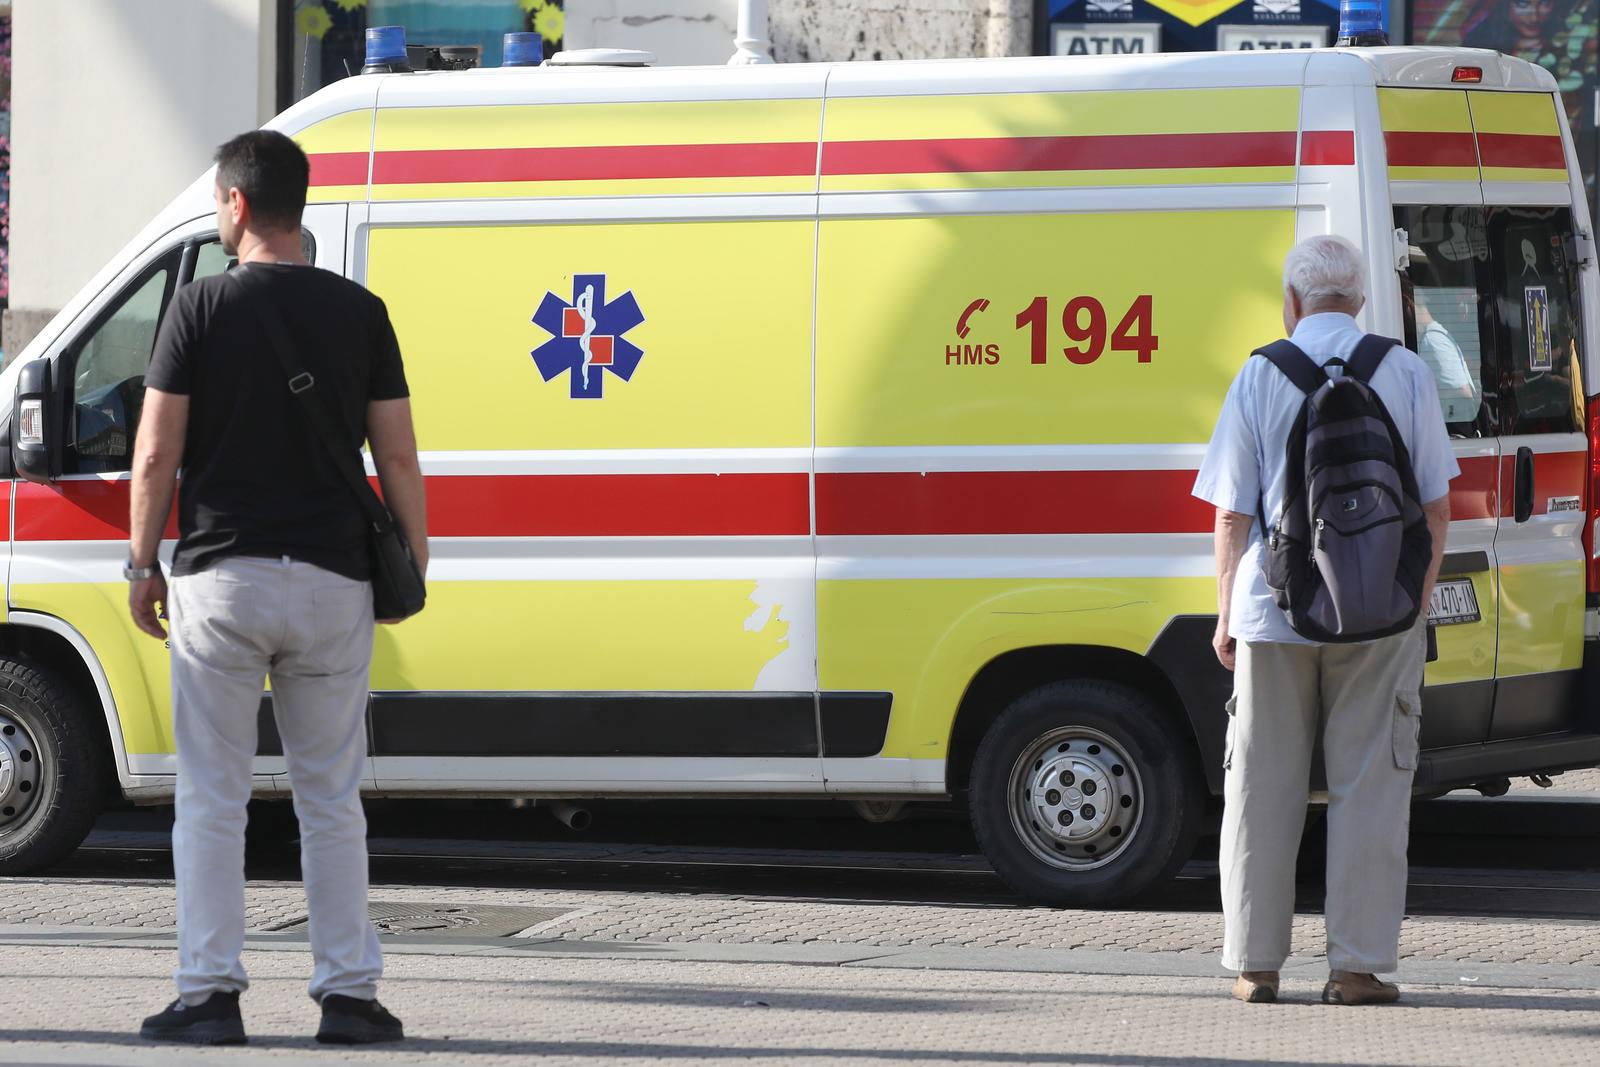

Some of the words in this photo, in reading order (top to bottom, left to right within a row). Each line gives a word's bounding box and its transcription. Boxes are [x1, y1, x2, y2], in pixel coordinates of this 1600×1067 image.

[1067, 37, 1144, 55] ATM
[1015, 294, 1159, 365] 194
[945, 343, 1000, 366] HMS
